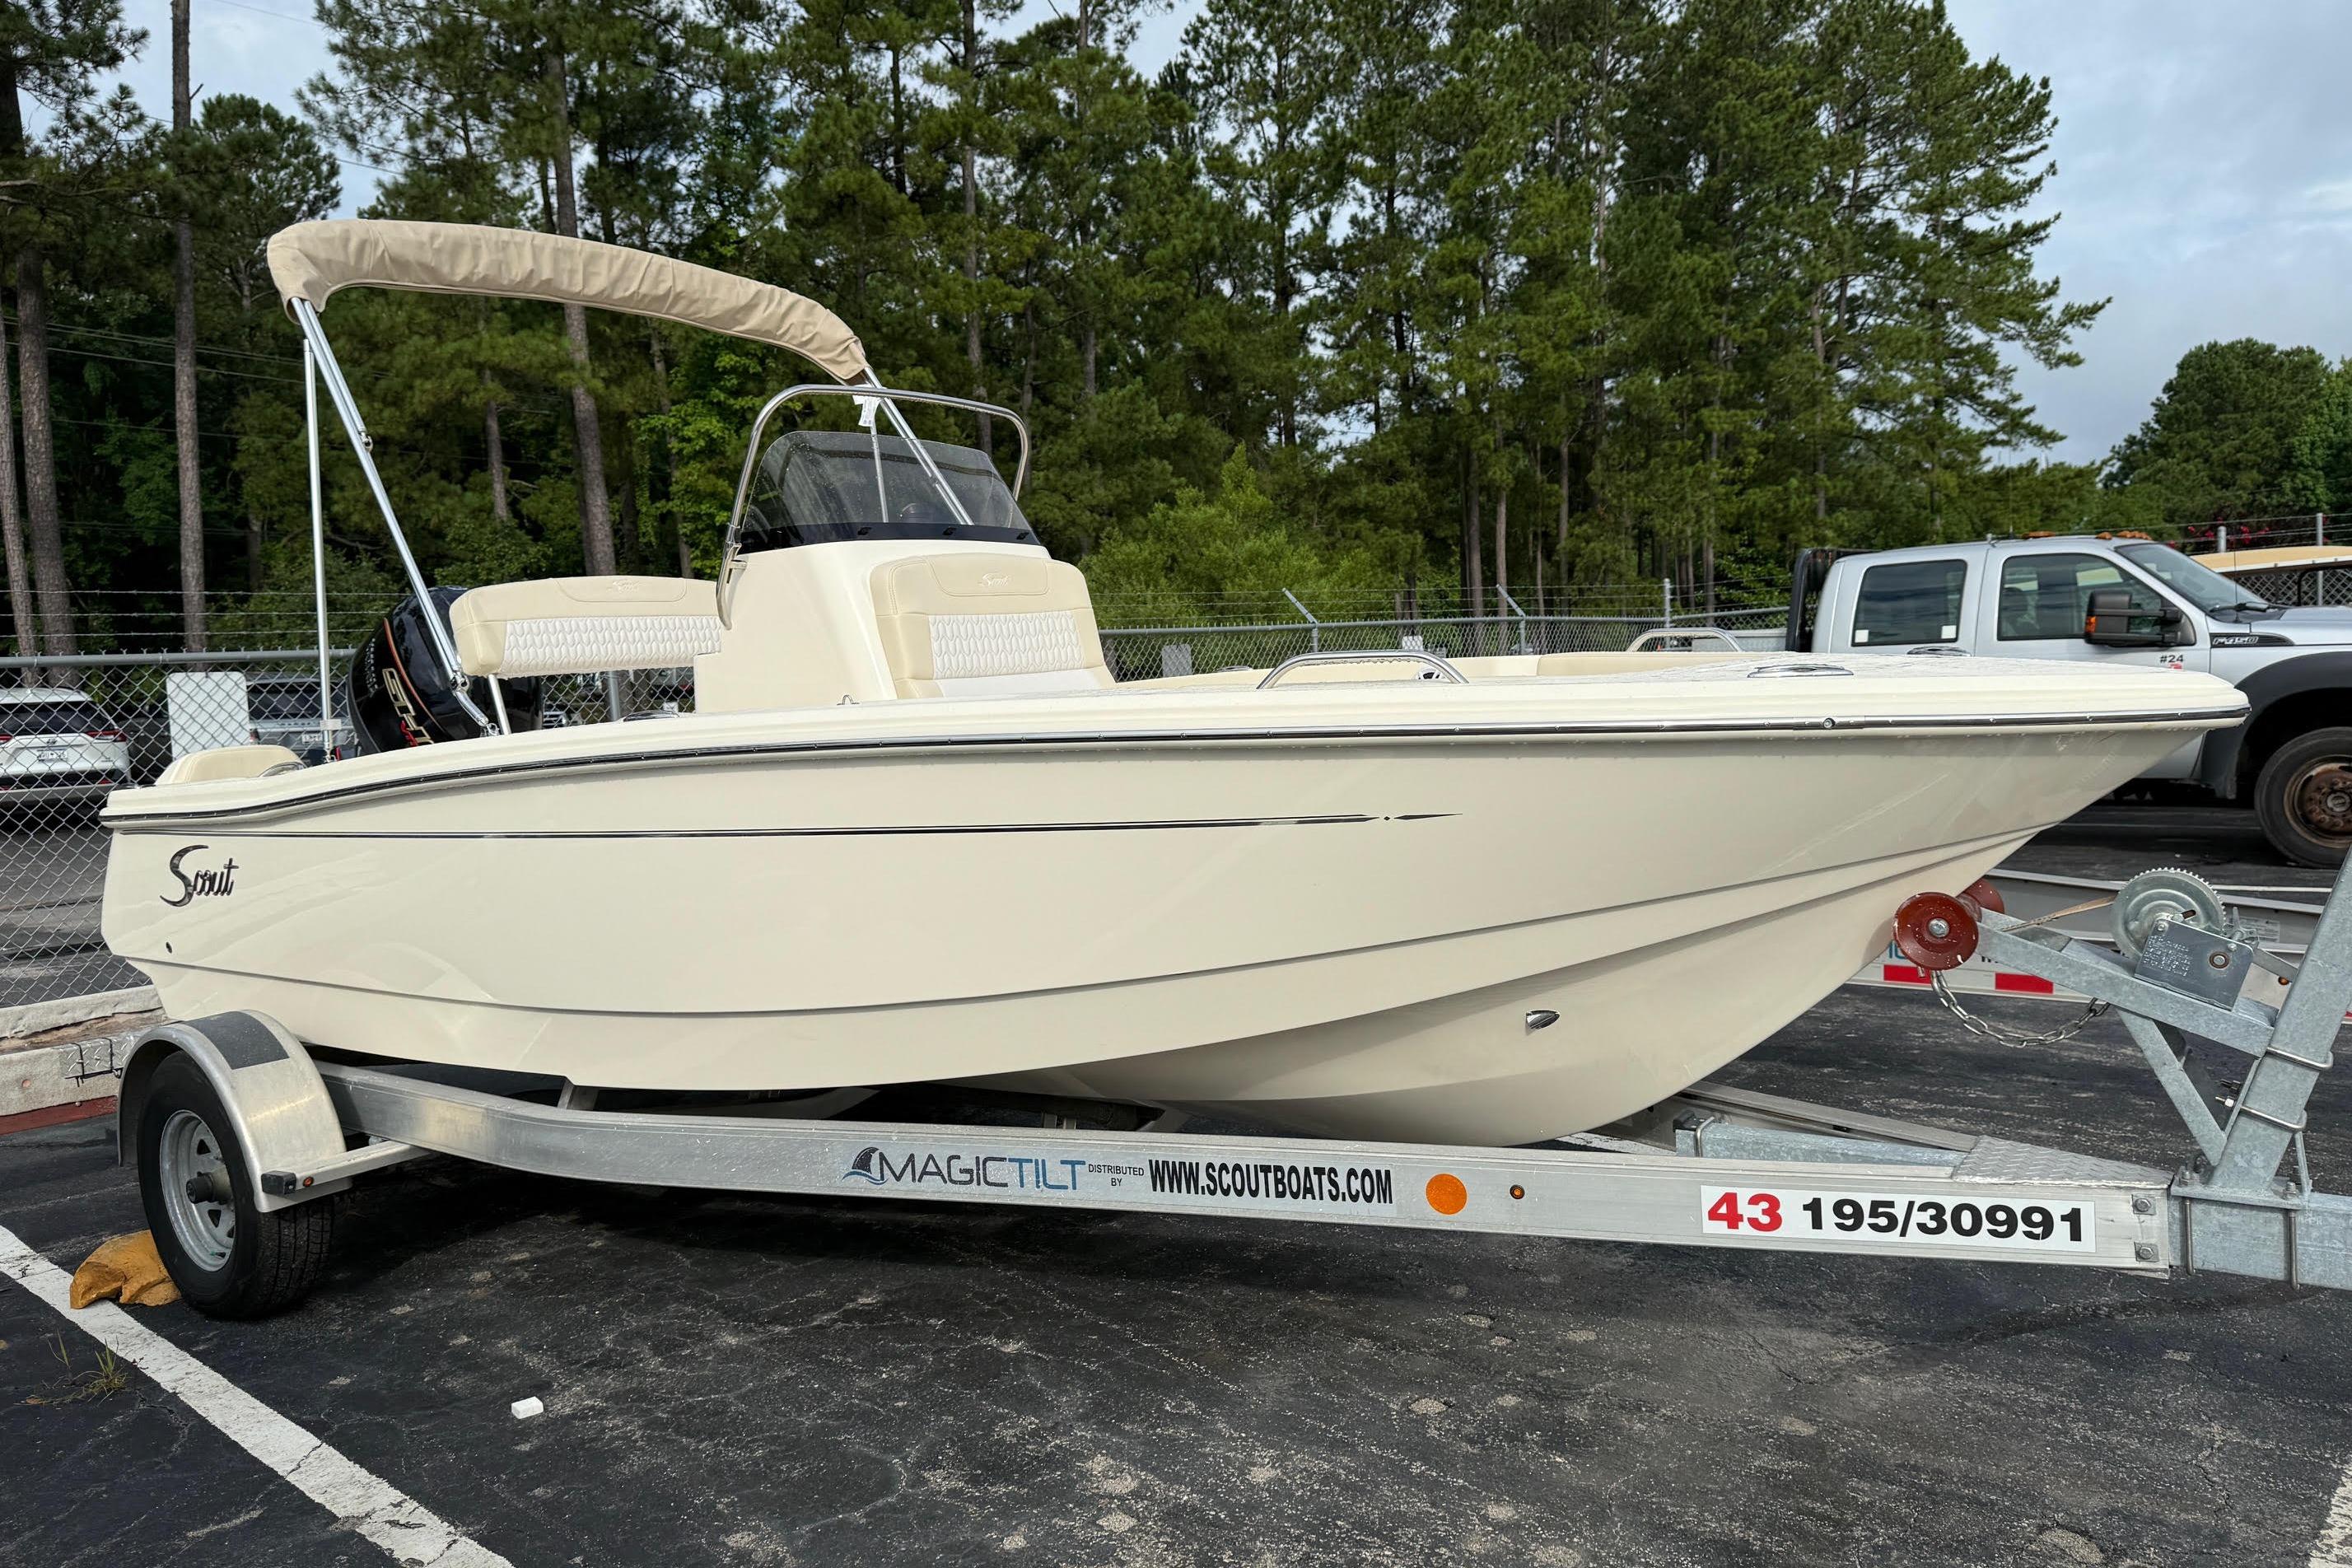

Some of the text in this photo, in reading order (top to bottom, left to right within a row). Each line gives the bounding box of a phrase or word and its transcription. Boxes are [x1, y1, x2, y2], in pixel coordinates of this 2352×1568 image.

[2159, 654, 2184, 664] #24
[159, 844, 240, 908] Scout
[878, 1151, 1086, 1191] MAGICTILT
[1088, 1163, 1146, 1177] DISTRIBUTED
[1111, 1177, 1123, 1188] BY
[1148, 1159, 1393, 1205] WWW.SCOUTBOATS.COM
[1707, 1192, 2083, 1243] 43 195/30991
